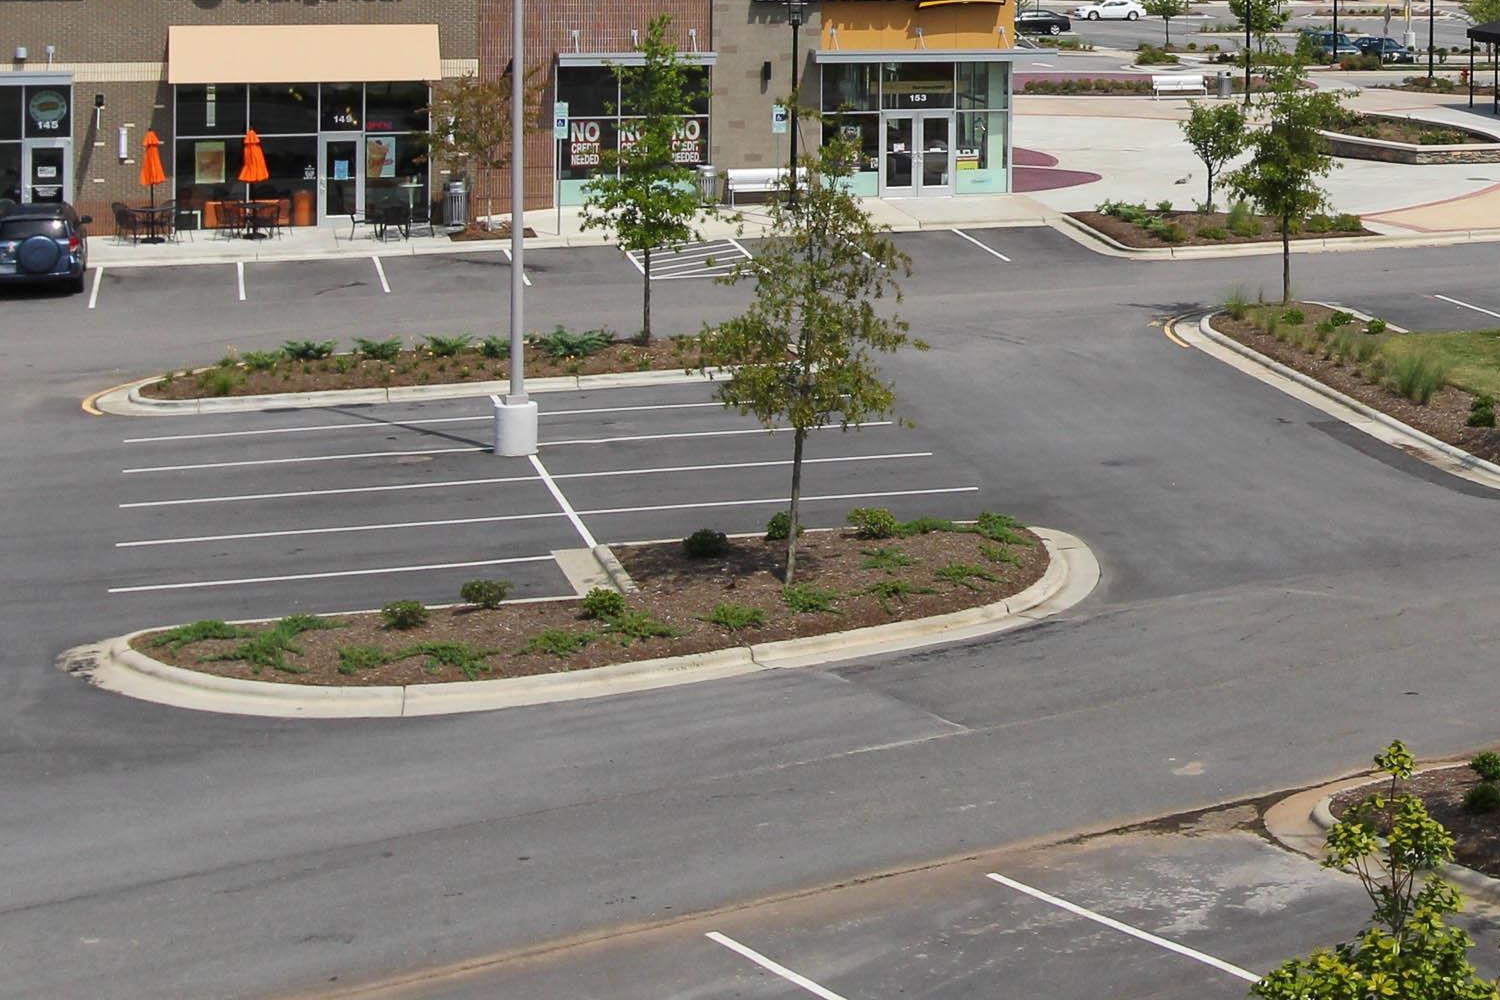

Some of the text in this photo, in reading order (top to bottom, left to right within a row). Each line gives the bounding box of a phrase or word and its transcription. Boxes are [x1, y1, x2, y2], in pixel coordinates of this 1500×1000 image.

[909, 94, 928, 102] 153
[571, 121, 600, 142] NO
[571, 142, 600, 154] CREDIT
[571, 154, 600, 165] NEEDED
